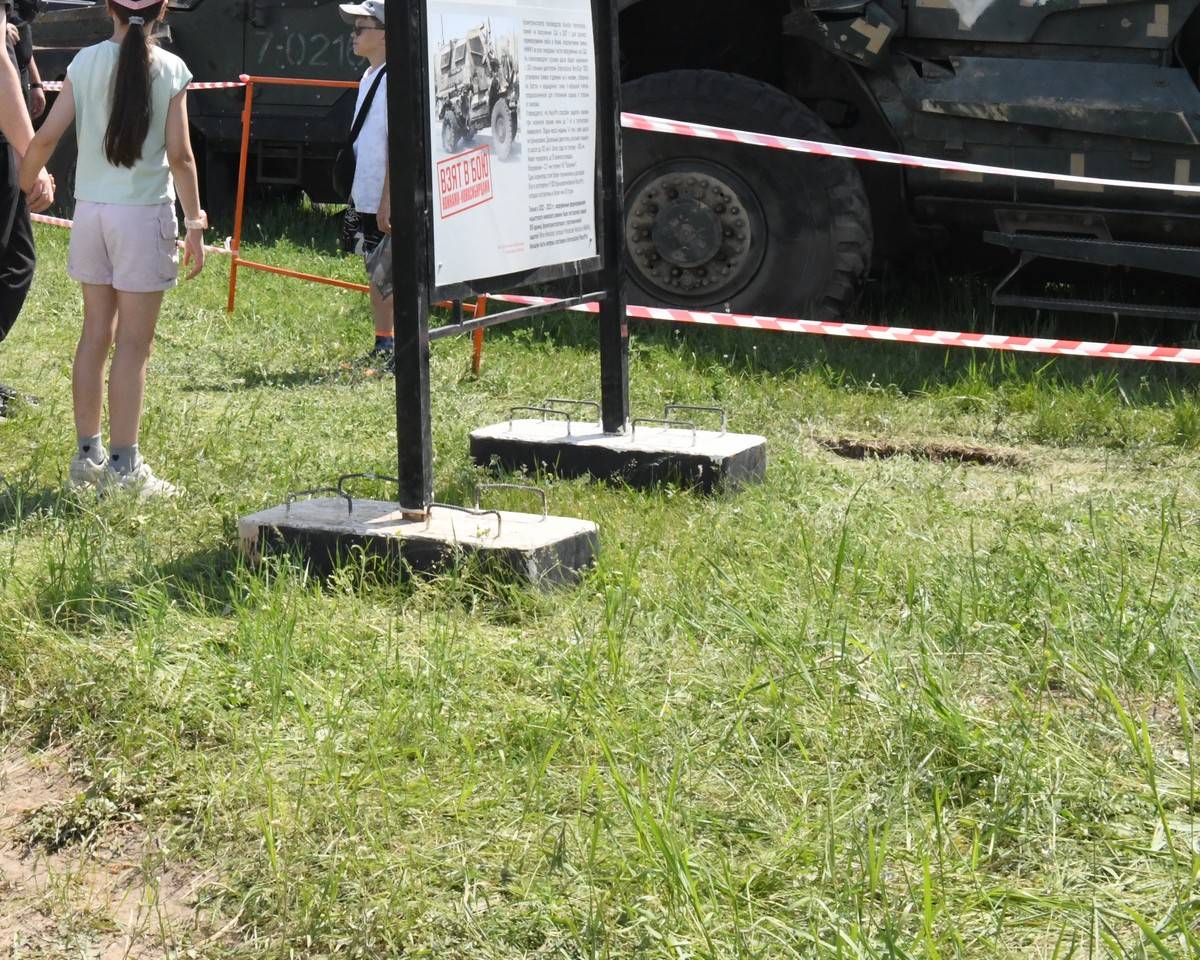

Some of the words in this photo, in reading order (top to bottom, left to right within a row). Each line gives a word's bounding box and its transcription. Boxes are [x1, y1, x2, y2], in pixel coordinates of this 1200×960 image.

[440, 162, 462, 194] ВЗЯТ
[463, 160, 470, 185] В
[470, 152, 489, 183] БОЮ
